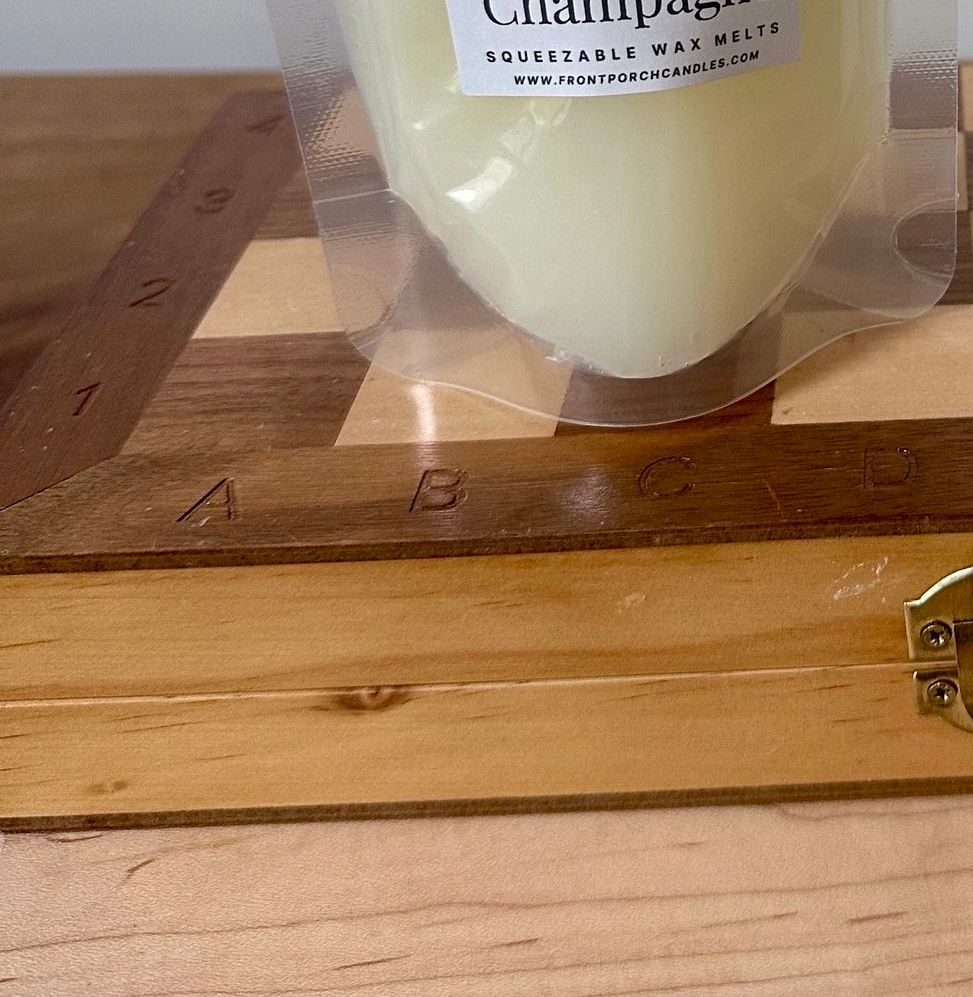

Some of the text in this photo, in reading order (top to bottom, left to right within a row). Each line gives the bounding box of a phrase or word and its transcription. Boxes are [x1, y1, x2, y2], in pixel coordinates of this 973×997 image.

[486, 21, 781, 63] SQUEEZABLE WAX MELTS
[514, 50, 760, 86] WWW.FRONTPORCHCANDLES.COM
[130, 277, 176, 308] 2
[72, 382, 101, 417] 1
[176, 476, 239, 523] A
[409, 467, 469, 513] B
[638, 455, 696, 497] C
[862, 446, 918, 491] D
